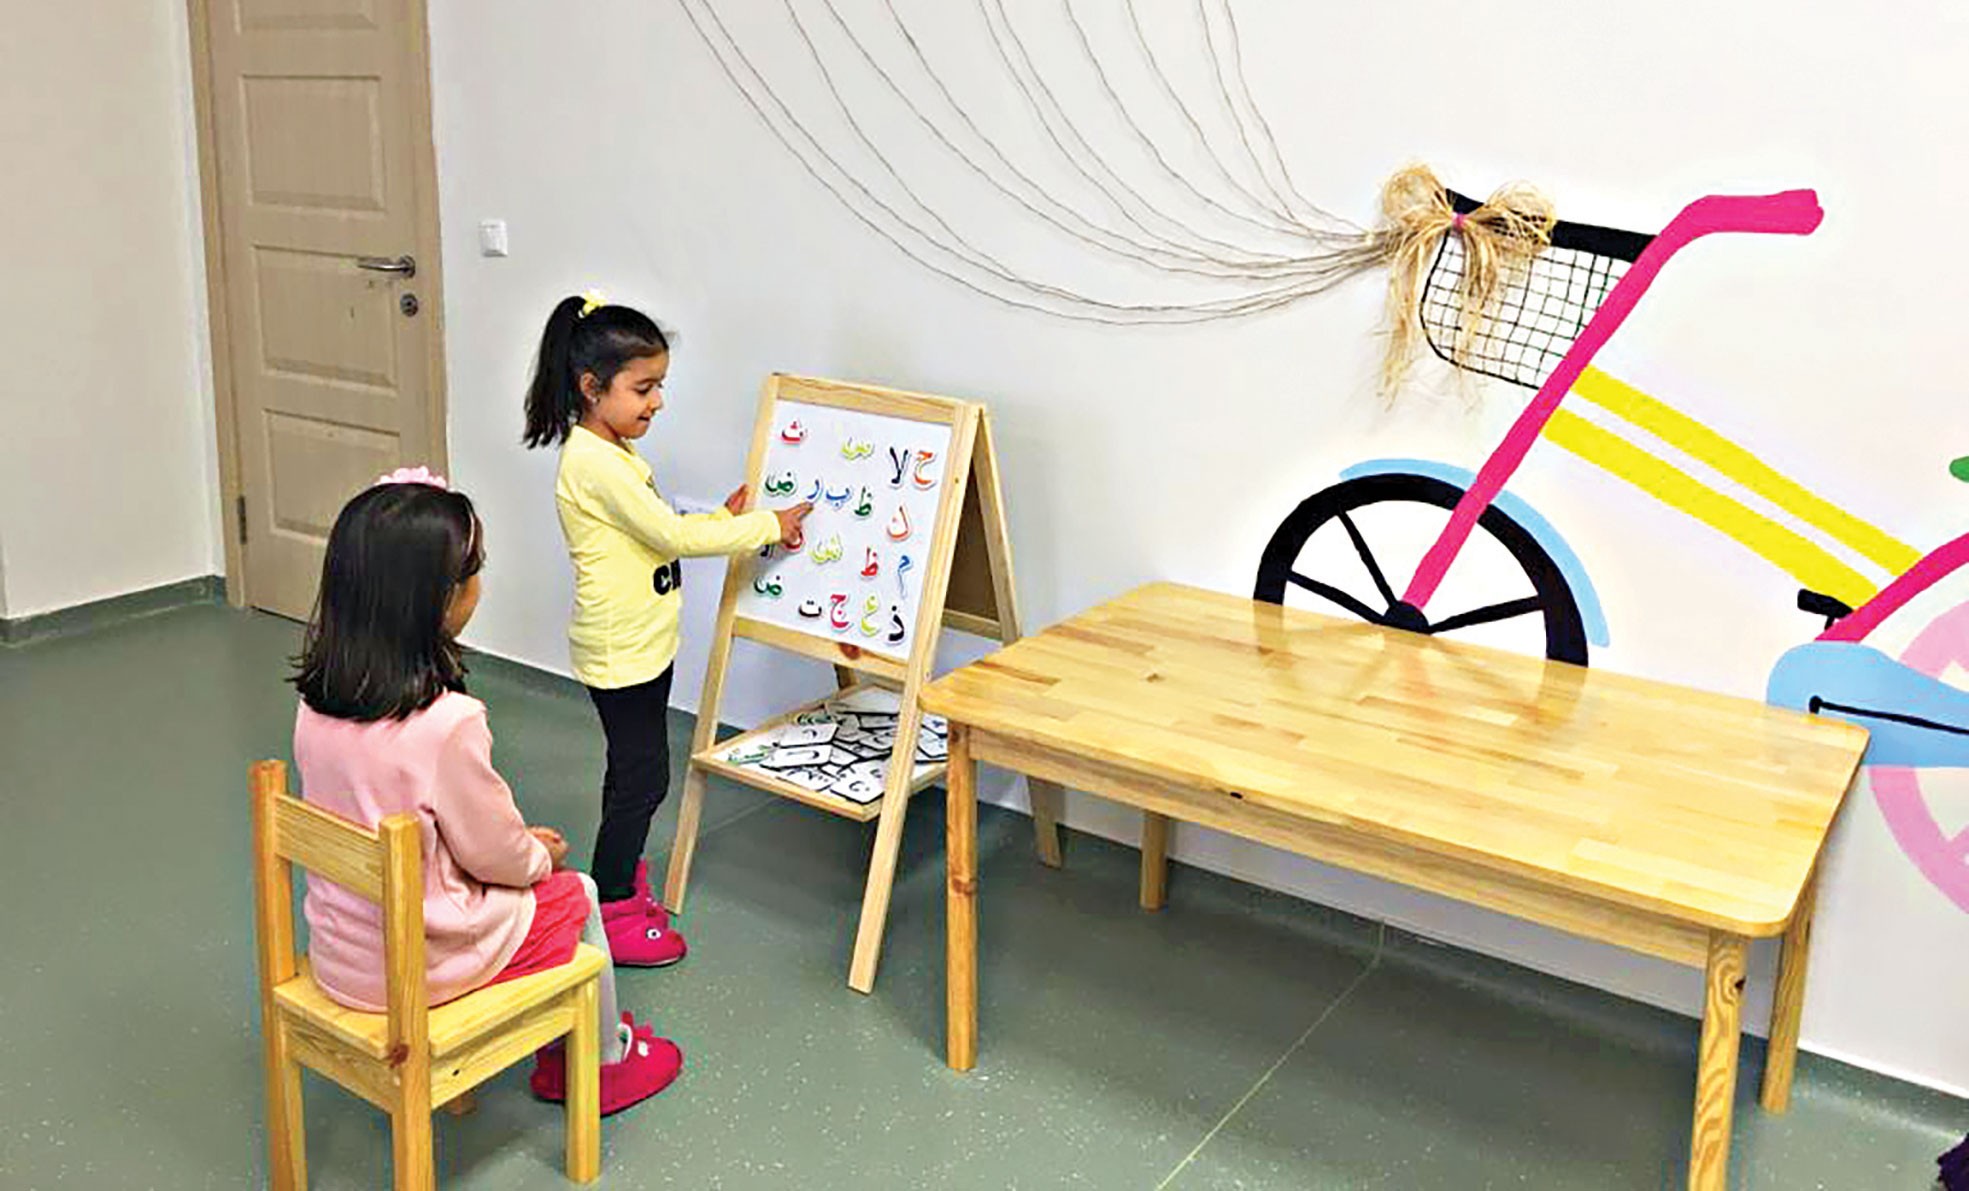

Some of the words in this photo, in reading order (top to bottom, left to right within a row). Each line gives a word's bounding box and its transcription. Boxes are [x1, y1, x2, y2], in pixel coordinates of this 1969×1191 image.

[781, 421, 804, 442] ث
[889, 447, 908, 484] لا
[914, 450, 933, 485] ح
[765, 472, 795, 493] ض
[807, 479, 820, 499] ر
[825, 487, 850, 507] ب
[854, 487, 872, 516] ظ
[861, 546, 878, 576] ظ
[754, 575, 783, 596] ض
[799, 601, 822, 618] ت
[830, 594, 850, 629] ج
[888, 606, 905, 642] ذ
